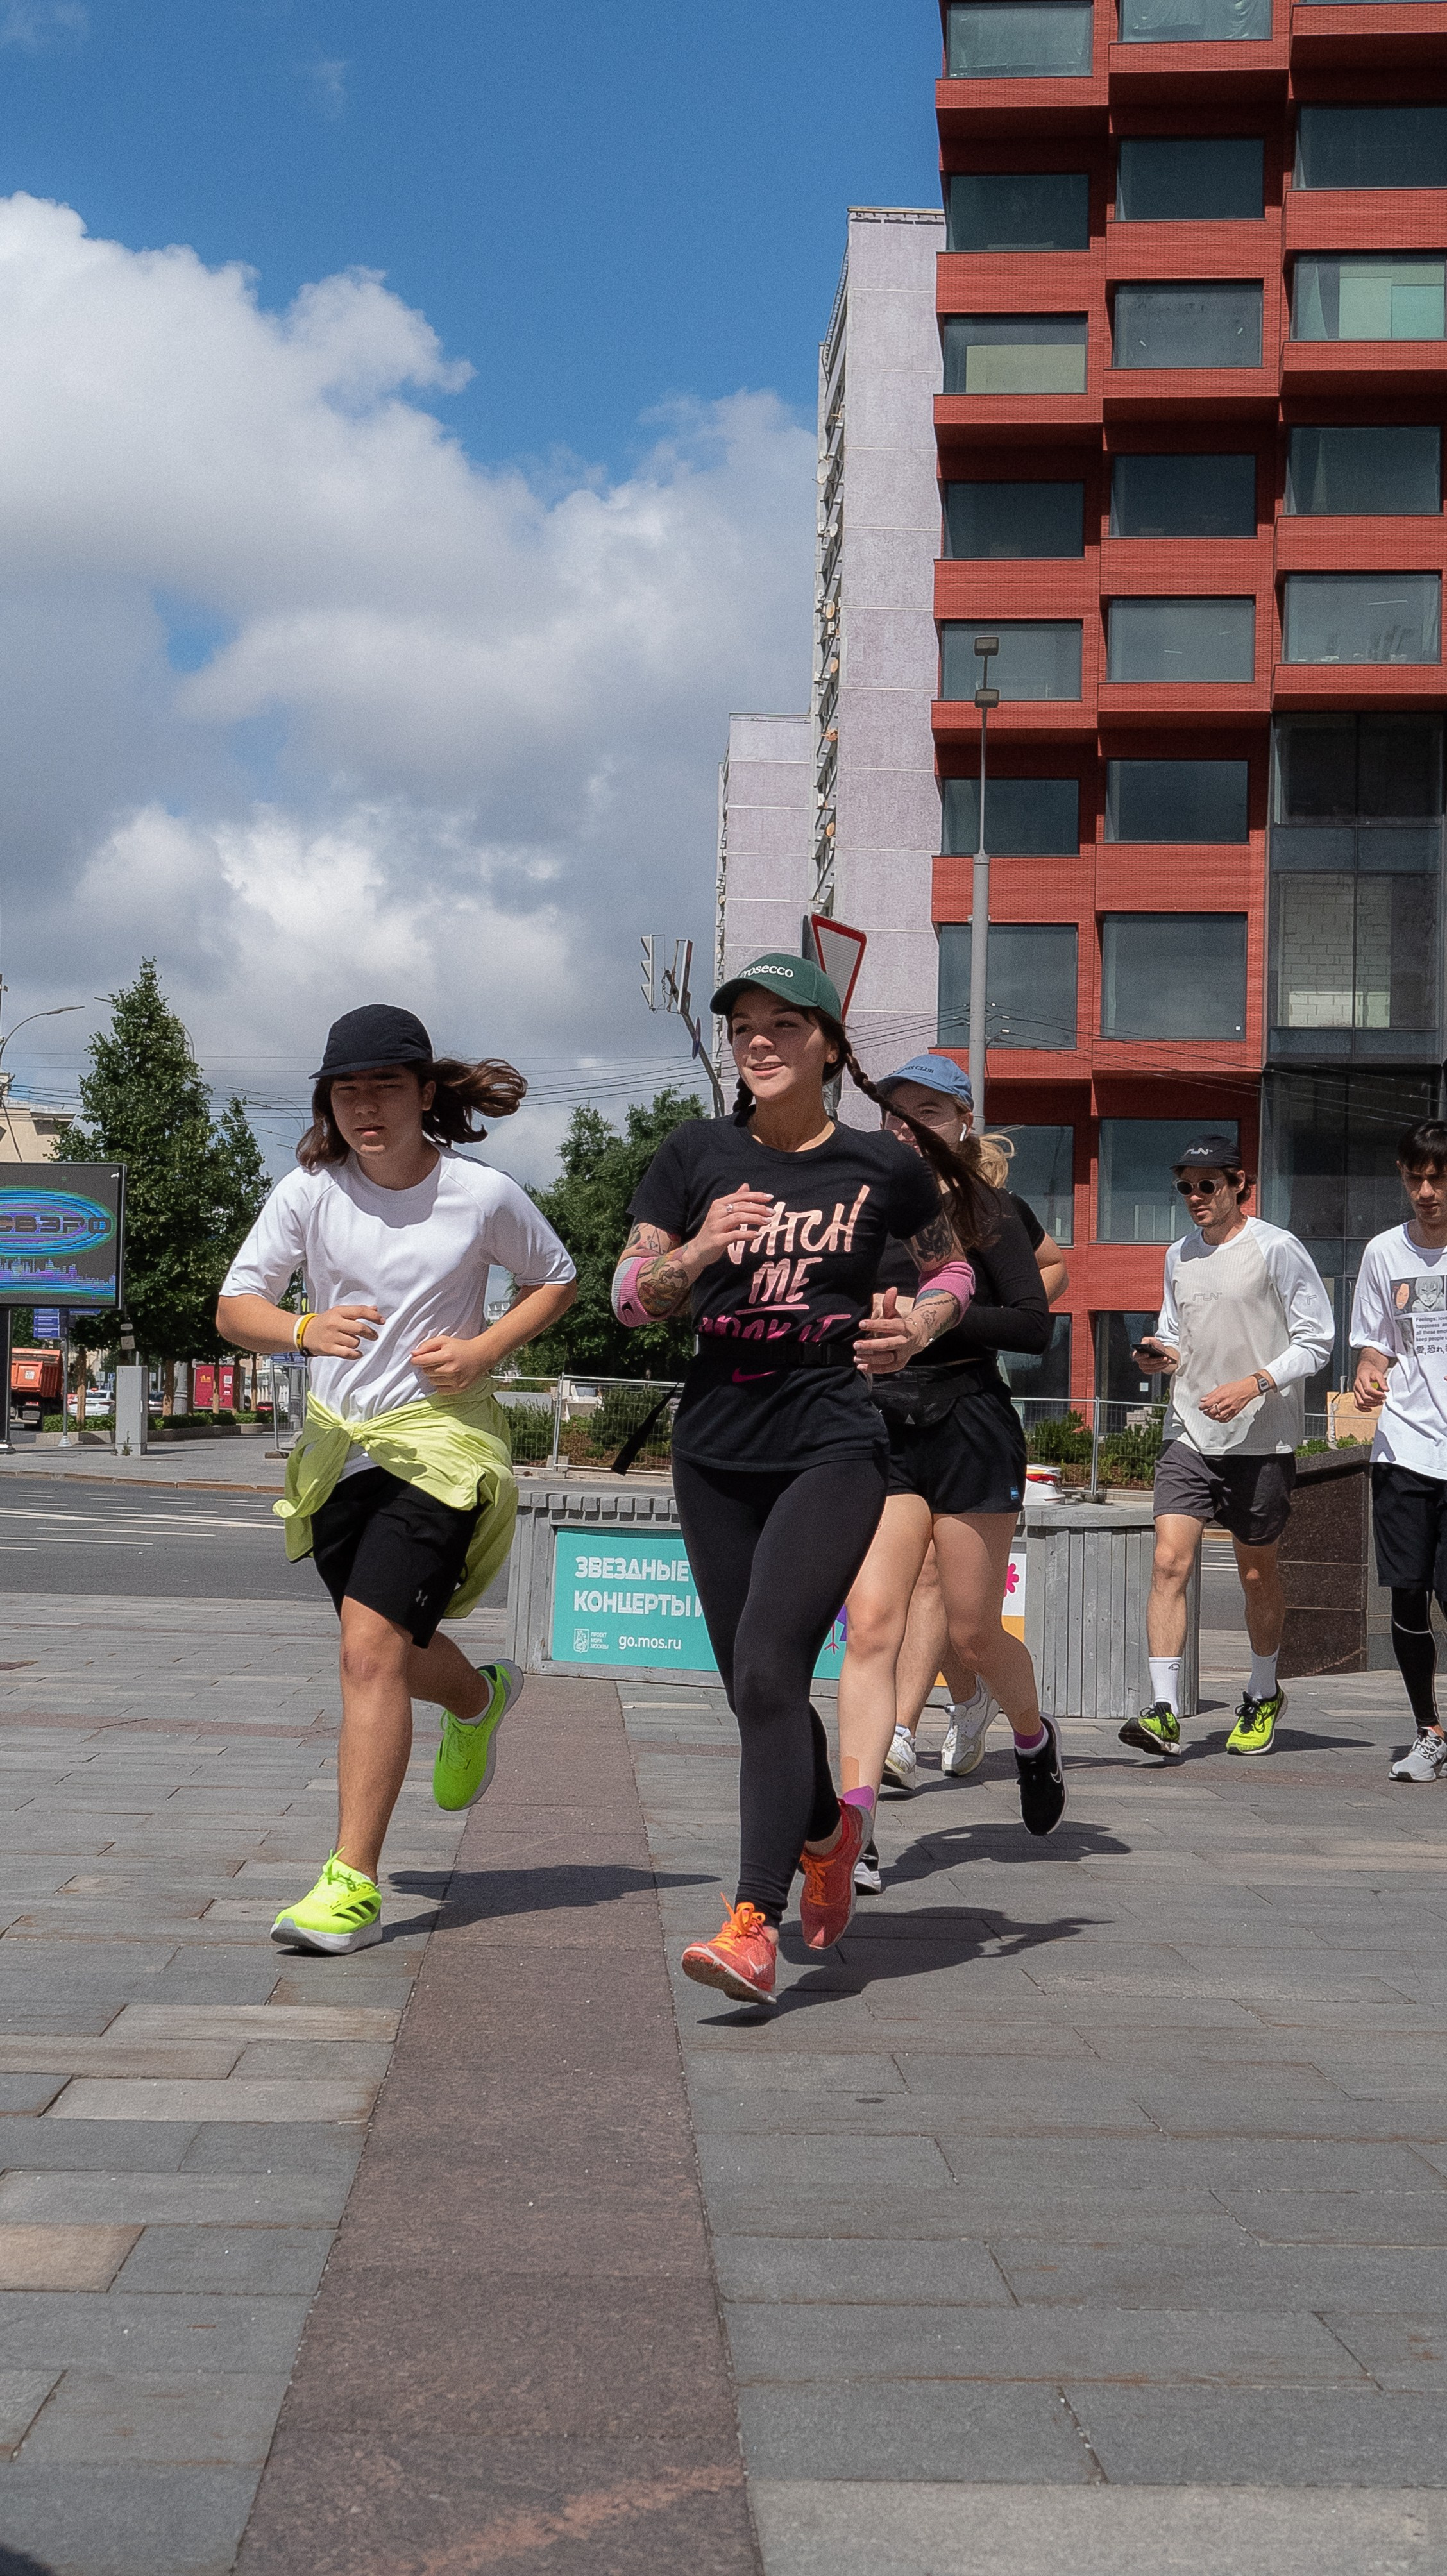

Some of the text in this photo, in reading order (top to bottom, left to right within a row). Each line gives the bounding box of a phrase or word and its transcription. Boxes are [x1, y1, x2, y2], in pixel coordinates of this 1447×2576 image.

[740, 965, 794, 978] rosecco
[915, 1065, 935, 1074] CLUB
[748, 1257, 824, 1305] ME
[575, 1556, 690, 1582] ЗВЕЗДНЫЕ
[574, 1590, 691, 1617] КОНЦЕРТЫ
[618, 1636, 682, 1650] go.mos.ru
